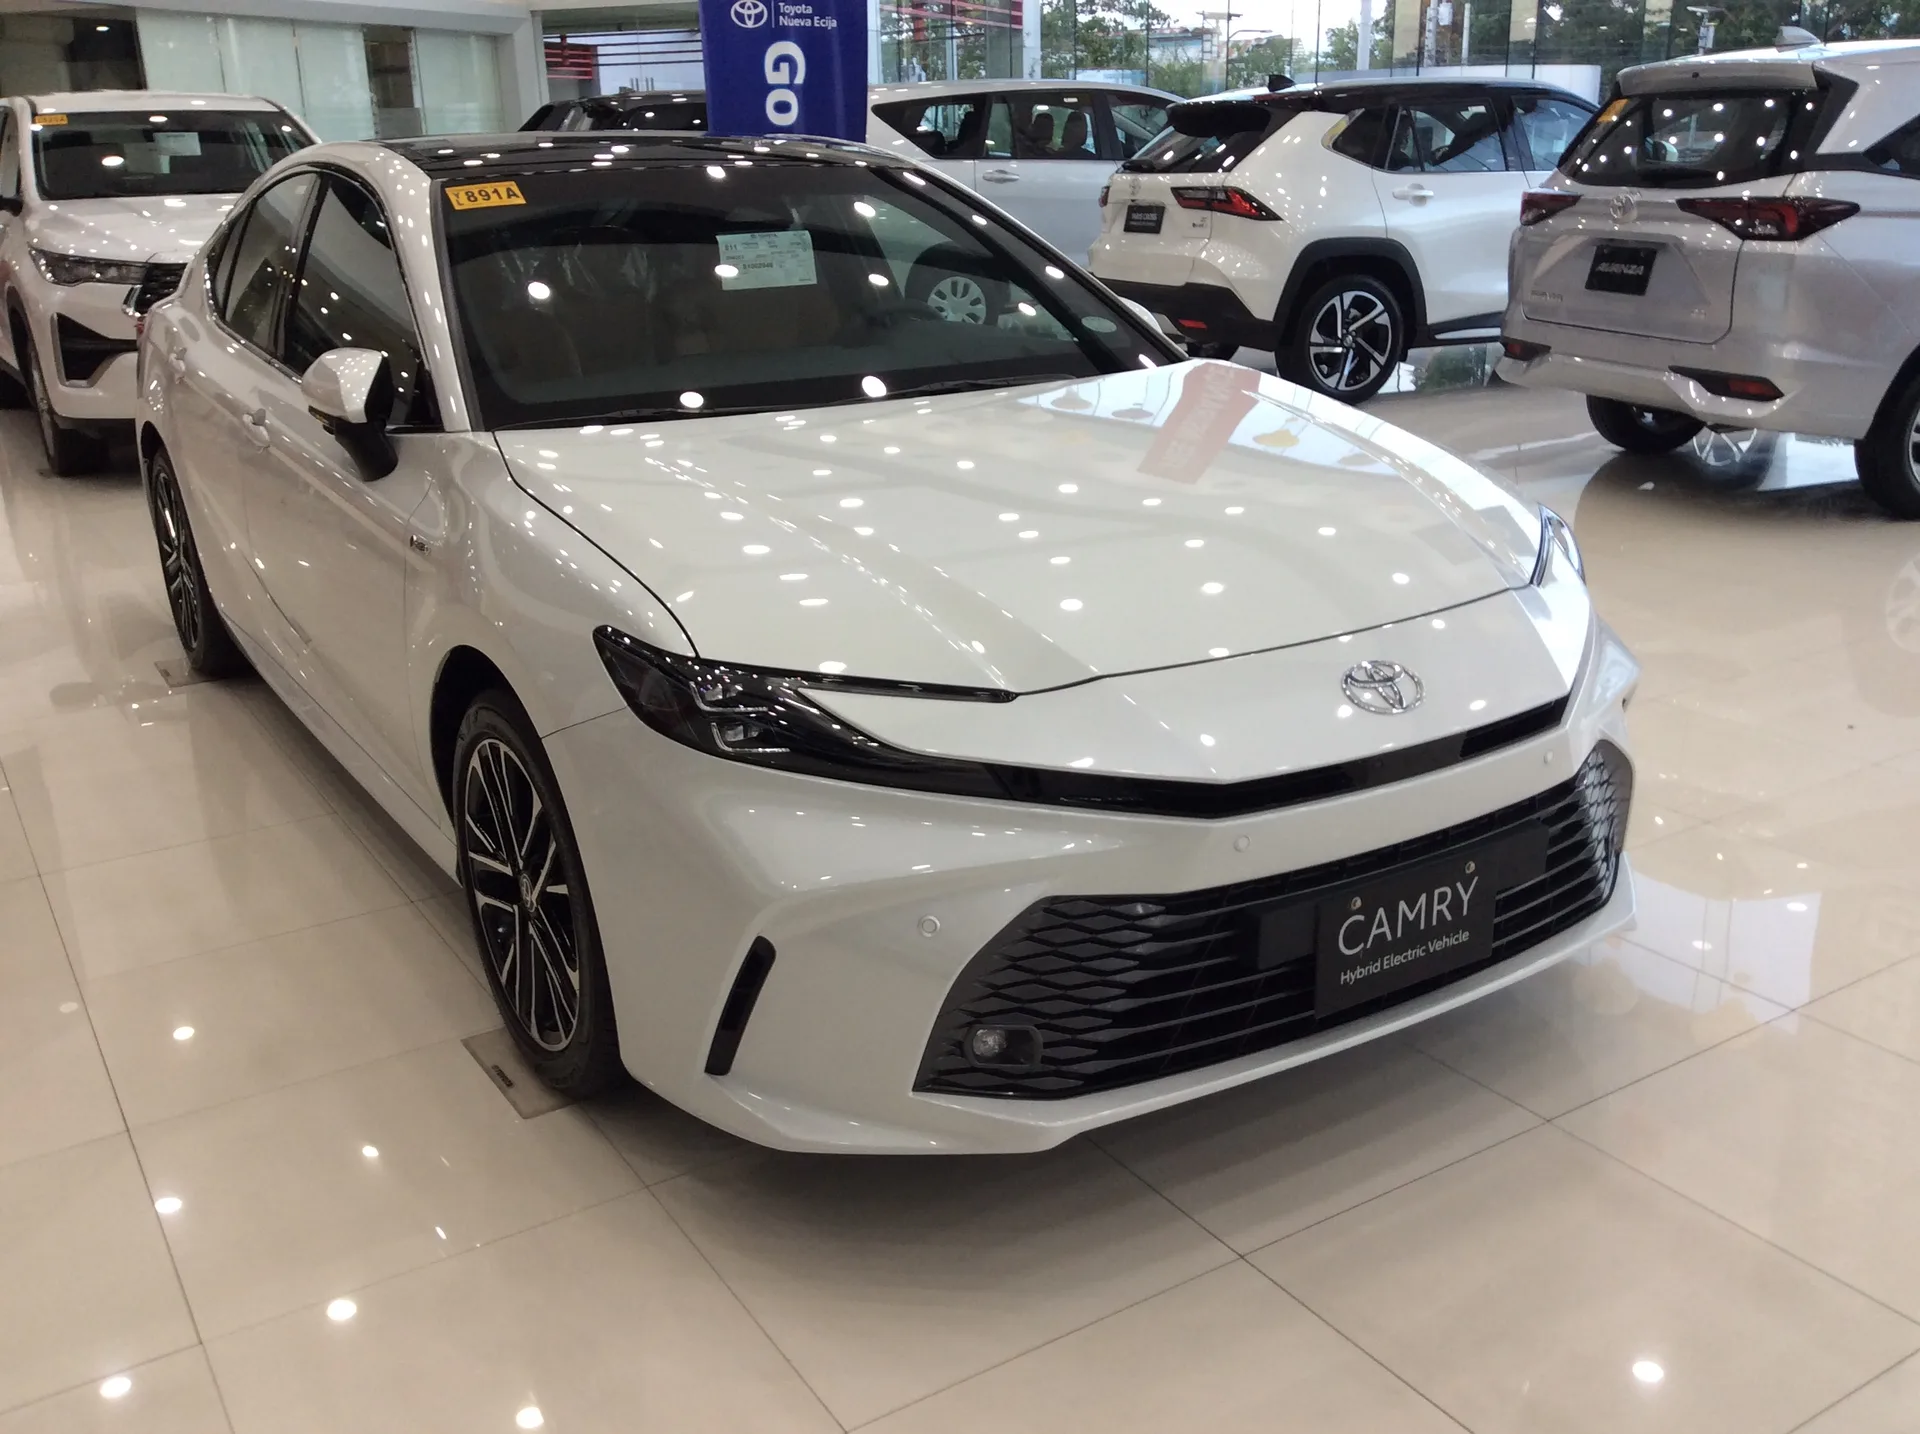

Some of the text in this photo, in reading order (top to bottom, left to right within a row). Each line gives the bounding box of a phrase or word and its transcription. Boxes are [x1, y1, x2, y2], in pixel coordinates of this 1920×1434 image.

[778, 2, 813, 15] Toyota
[778, 16, 838, 30] Nueva Ecija
[764, 41, 806, 126] GO
[465, 187, 520, 203] 891A
[1338, 876, 1479, 956] CAMRY
[1340, 929, 1470, 985] Hybrid Electric Vehicle
